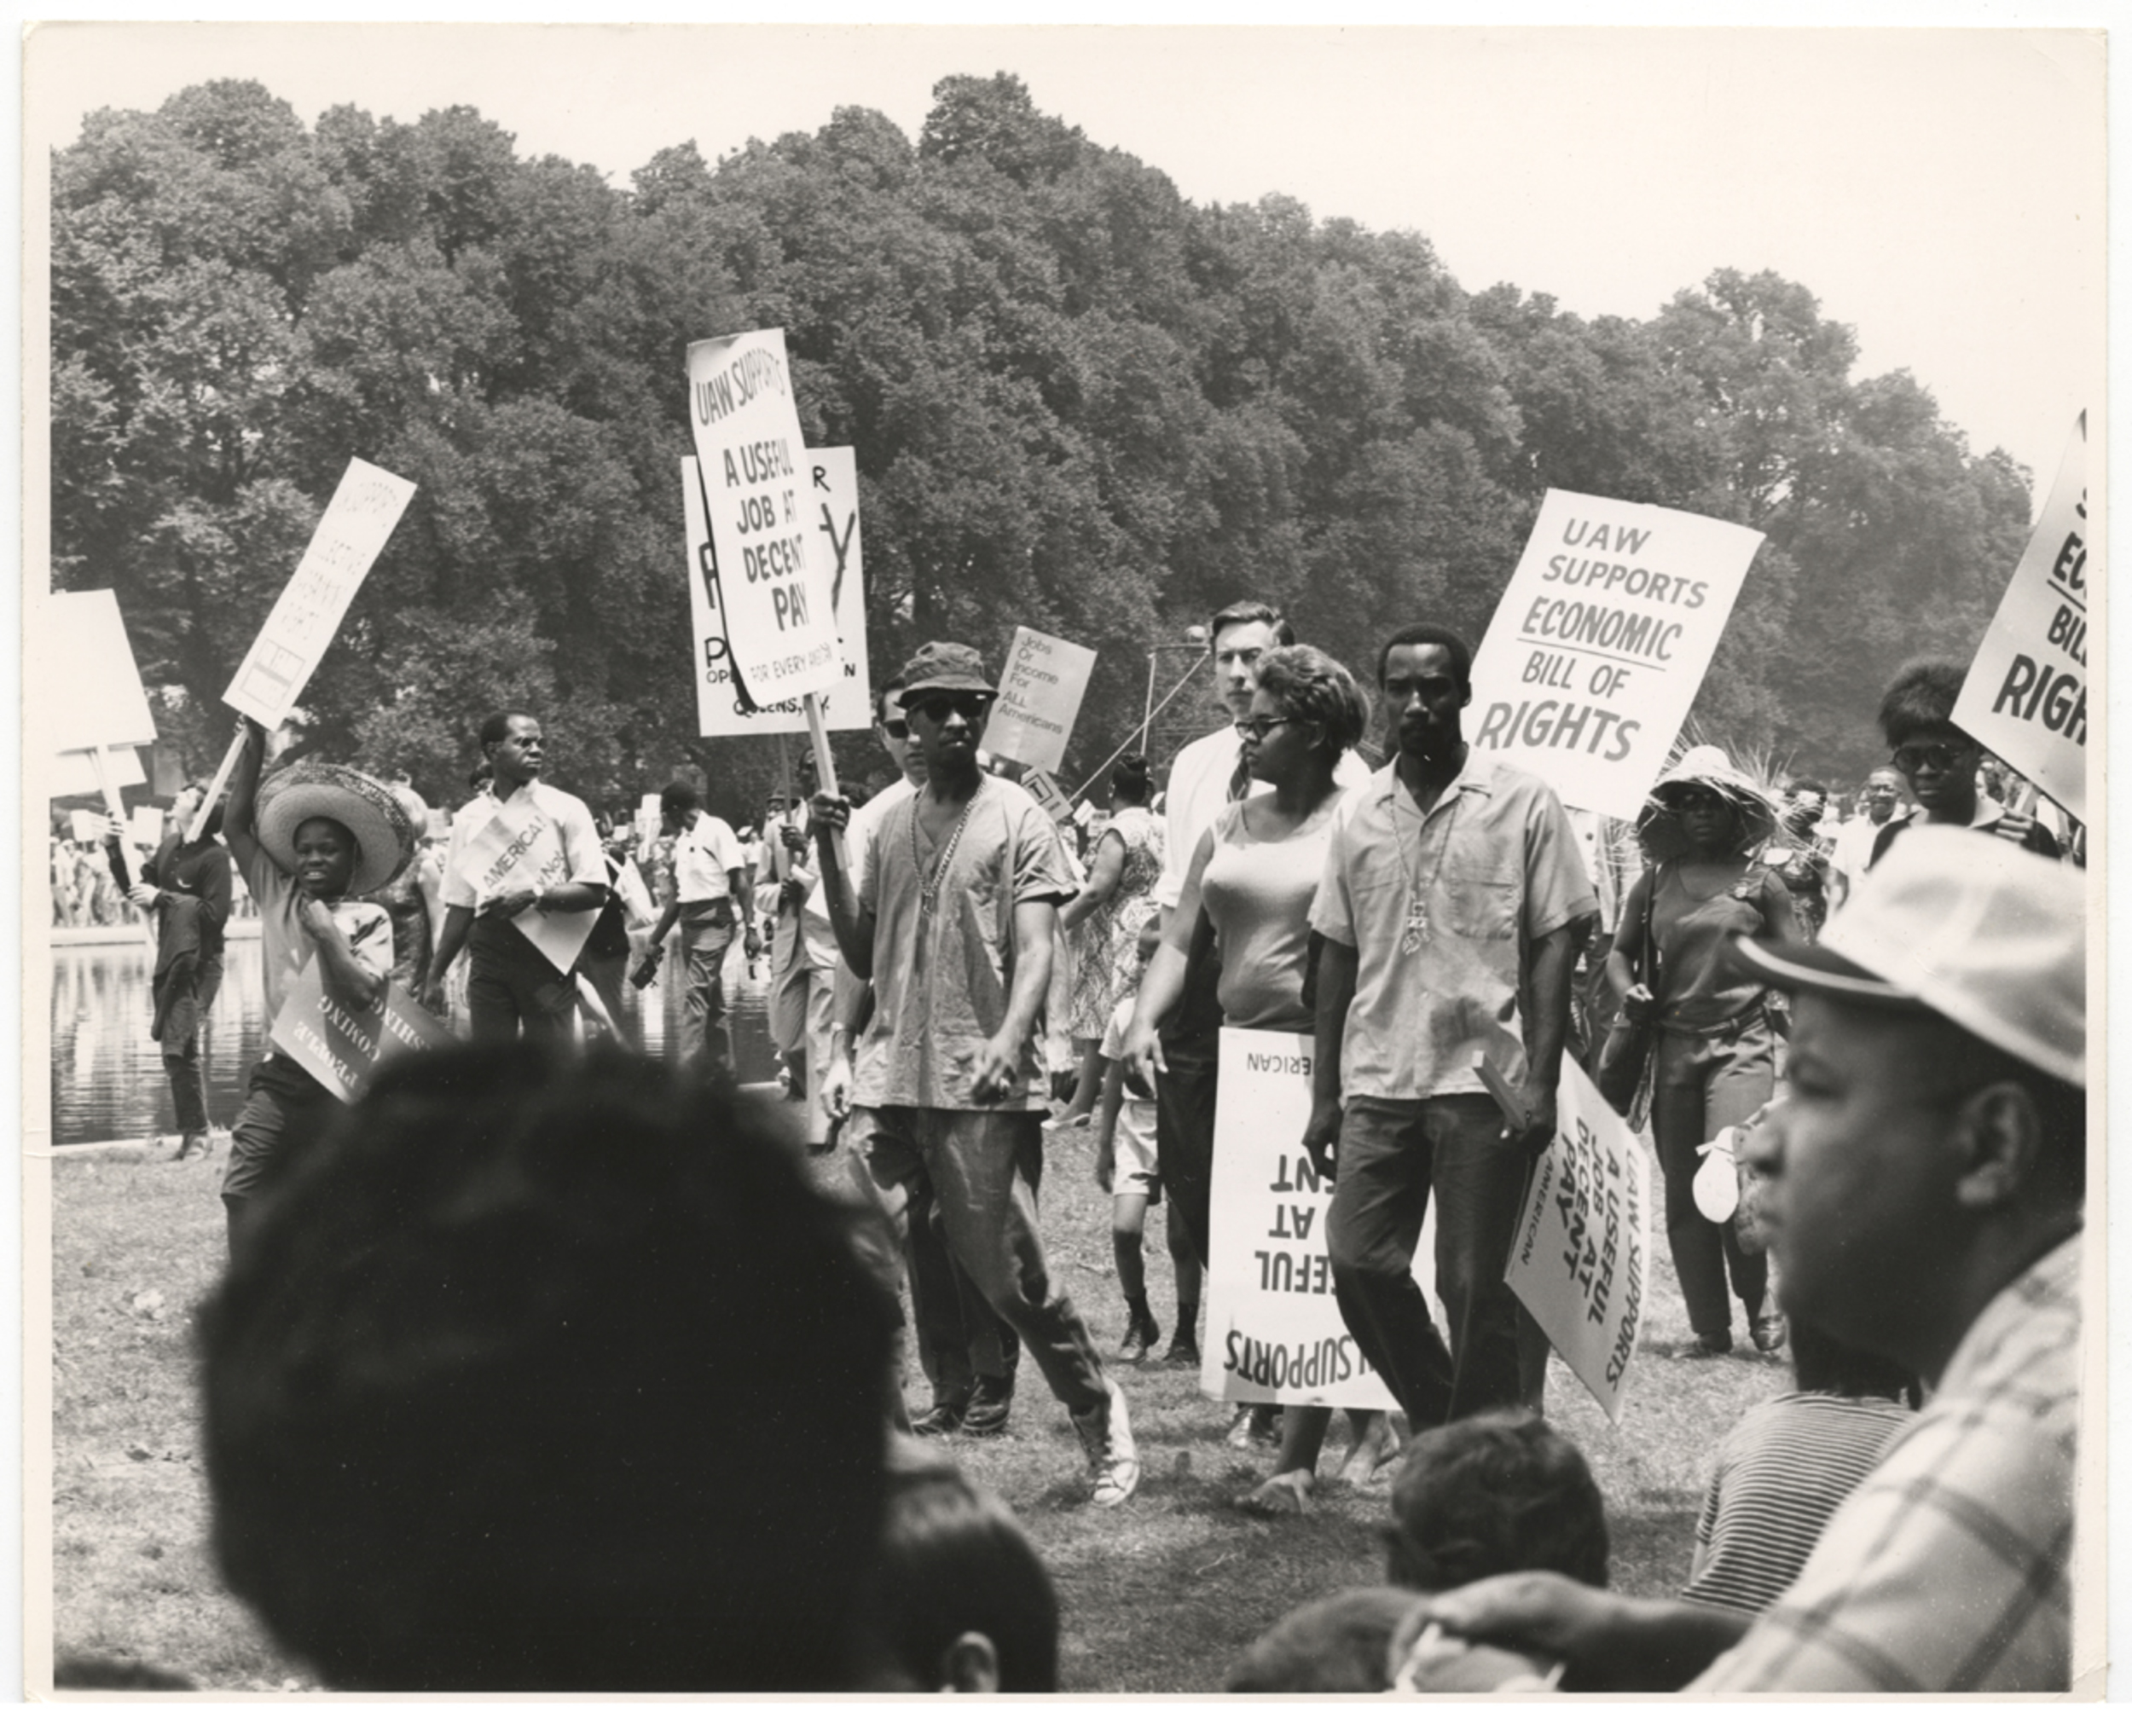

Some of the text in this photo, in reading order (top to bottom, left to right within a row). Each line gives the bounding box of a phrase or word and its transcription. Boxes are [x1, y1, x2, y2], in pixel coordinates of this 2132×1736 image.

[696, 347, 785, 426] UAW SUPPORTS
[722, 448, 741, 488] A
[739, 437, 794, 484] USEFUL
[737, 489, 798, 535] JOB AT
[1561, 518, 1652, 556] UAW
[742, 532, 807, 584] DECENT
[1541, 553, 1710, 610] SUPPORTS
[772, 582, 809, 631] PAY
[1521, 594, 1683, 663] ECONOMIC
[750, 664, 770, 683] FOR
[773, 654, 807, 680] EVERY
[1017, 648, 1034, 663] Or
[1020, 635, 1053, 656] Jobs
[1009, 674, 1032, 689] For
[1012, 662, 1060, 686] Income
[1521, 650, 1631, 699] BILL OF
[999, 706, 1063, 735] Americans
[1002, 691, 1027, 709] ALL
[1474, 699, 1642, 763] RIGHTS
[482, 815, 548, 890] AMERICA!
[317, 994, 381, 1062] COMING
[293, 1020, 360, 1088] PEOPLE
[1247, 1052, 1312, 1076] ERICAN
[1555, 1132, 1577, 1229] PAY
[1562, 1115, 1590, 1282] DECENT
[1268, 1204, 1316, 1240] AT
[1521, 1157, 1555, 1266] AMERICAN
[1577, 1134, 1605, 1299] JOB AT
[1587, 1147, 1620, 1327] A USEFUL
[1254, 1250, 1335, 1296] EFUL
[1606, 1148, 1642, 1393] UAW SUPPORTS
[1222, 1328, 1353, 1388] SUPPORTS
